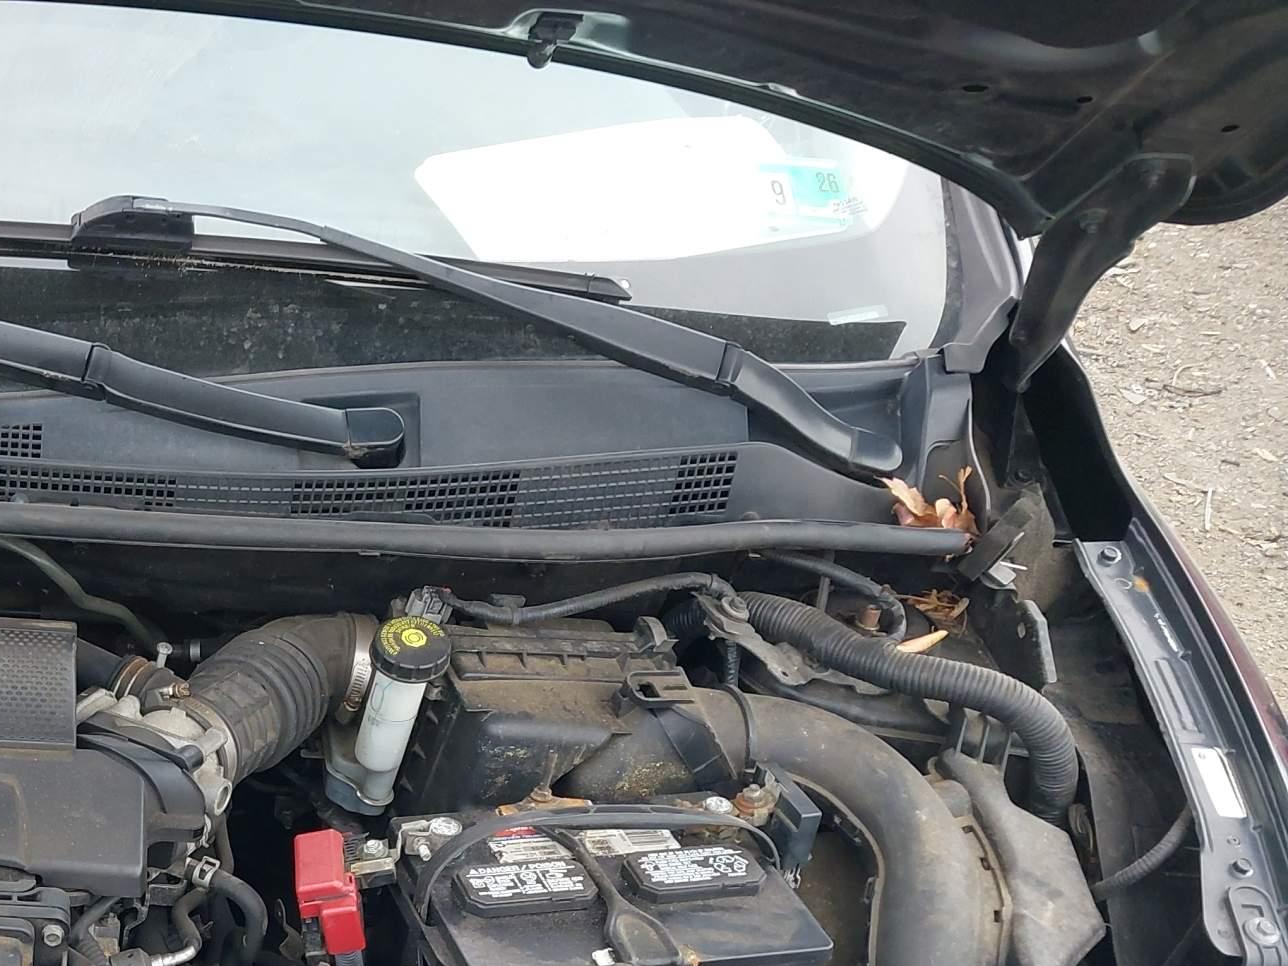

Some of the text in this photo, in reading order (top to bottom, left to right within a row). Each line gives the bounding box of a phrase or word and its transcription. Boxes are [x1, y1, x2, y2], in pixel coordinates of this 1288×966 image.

[815, 171, 840, 193] 26
[479, 865, 521, 874] DANGER
[528, 861, 567, 870] POISON
